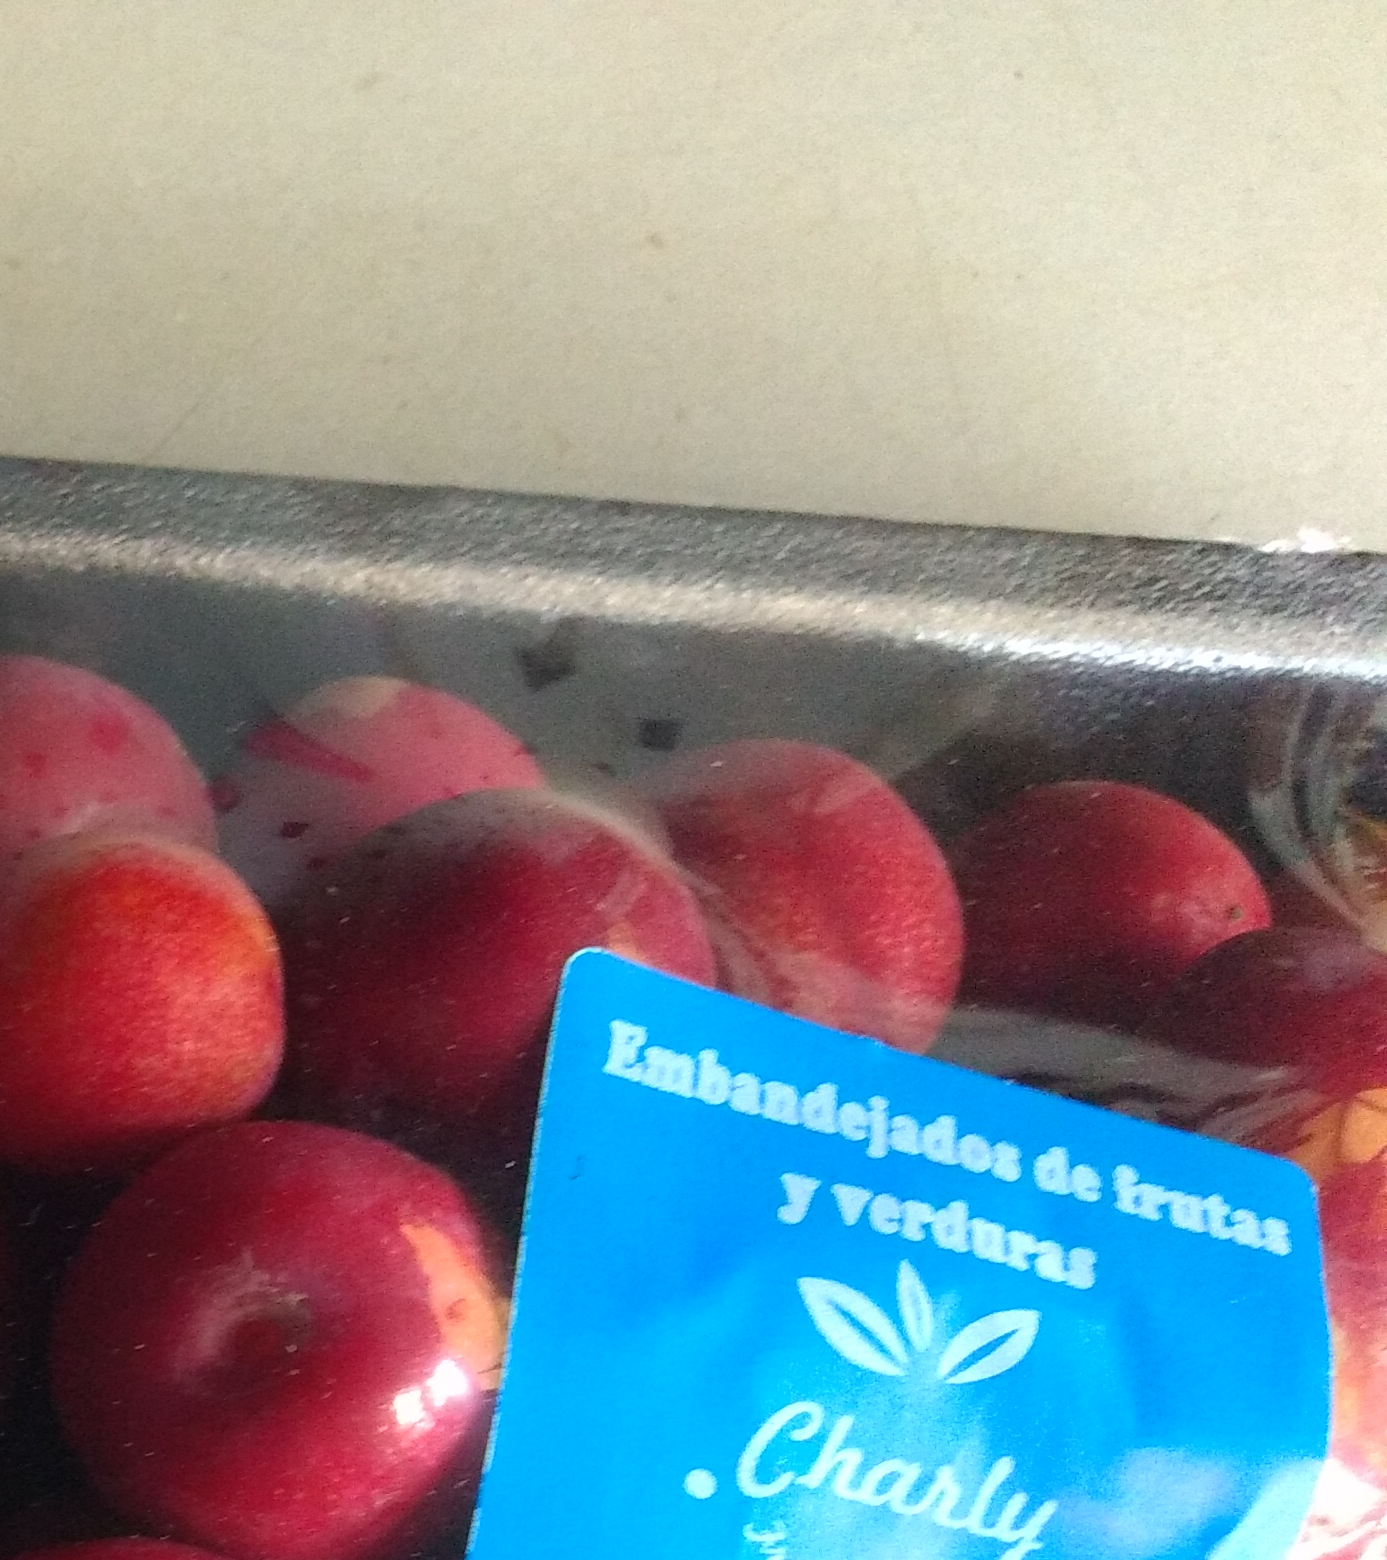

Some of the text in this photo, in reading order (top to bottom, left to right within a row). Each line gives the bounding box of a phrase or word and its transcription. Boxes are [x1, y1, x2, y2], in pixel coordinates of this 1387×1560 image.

[602, 1019, 1292, 1256] Embandejados de frutas
[777, 1172, 1097, 1289] y verduras
